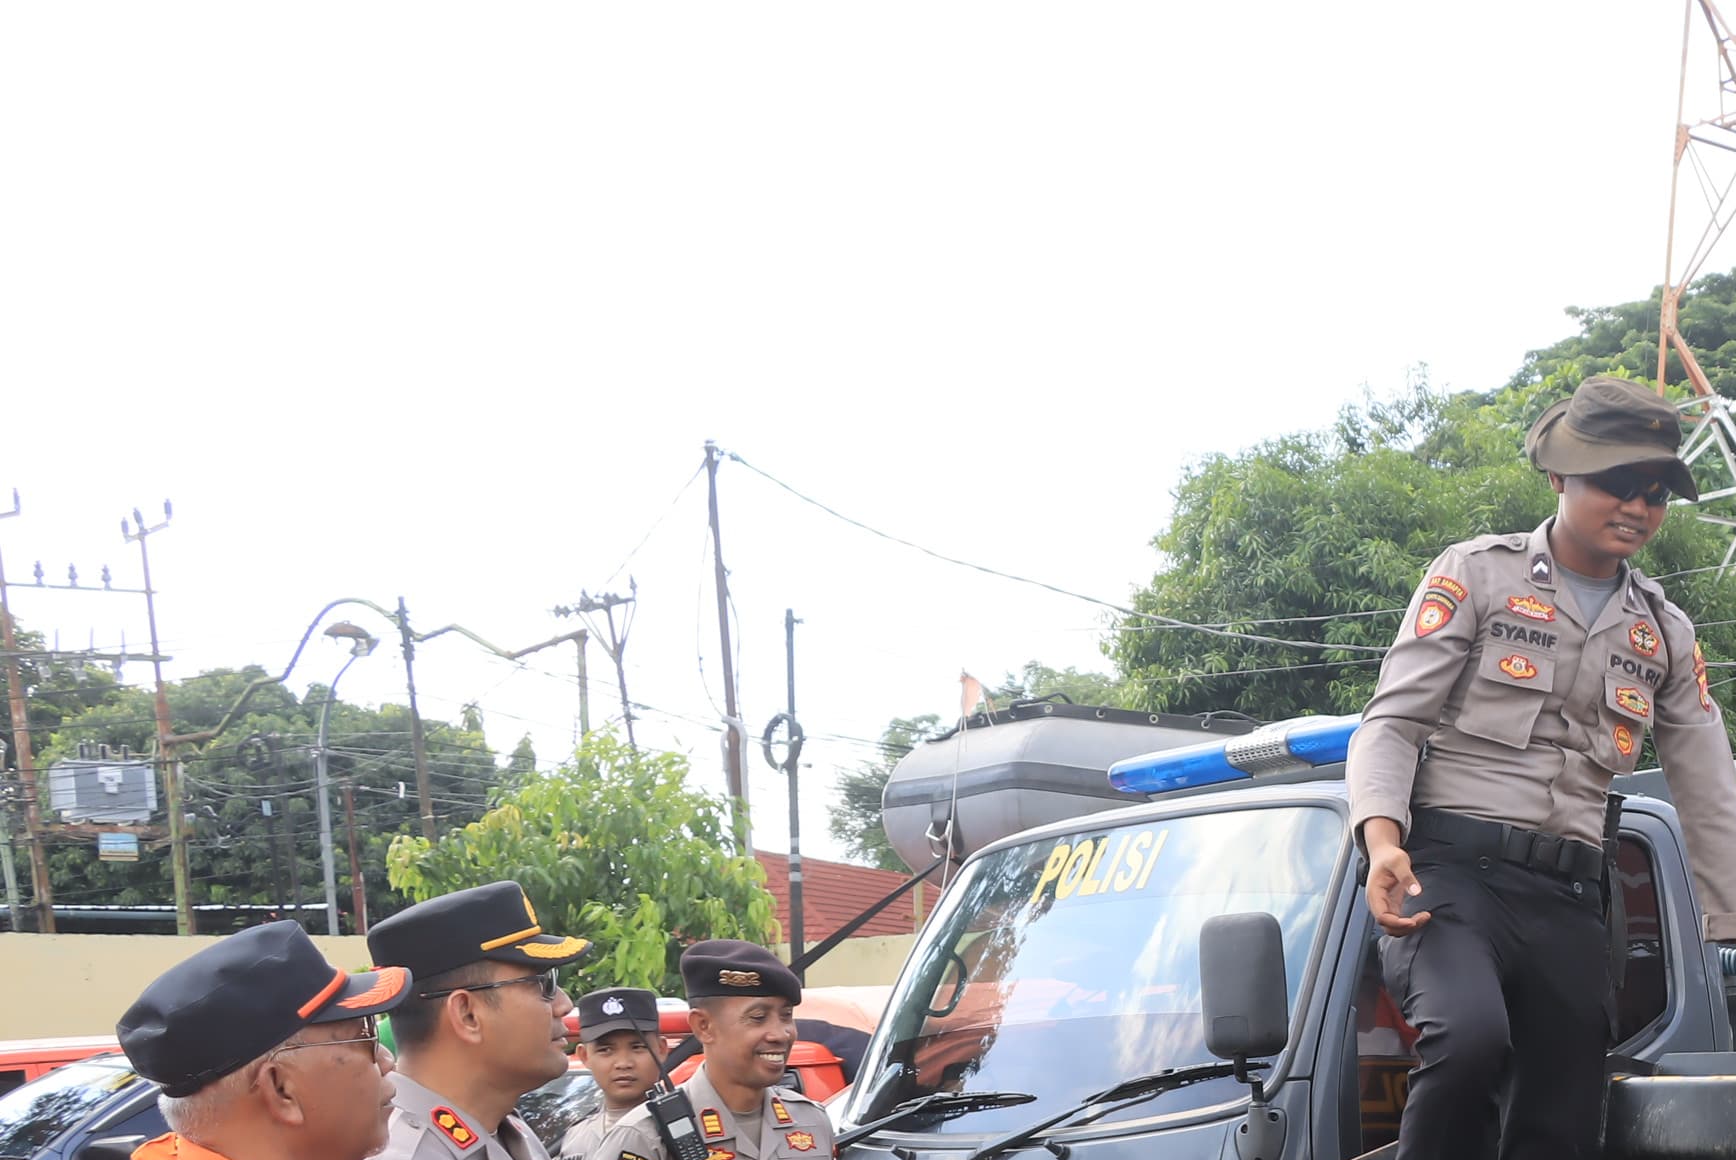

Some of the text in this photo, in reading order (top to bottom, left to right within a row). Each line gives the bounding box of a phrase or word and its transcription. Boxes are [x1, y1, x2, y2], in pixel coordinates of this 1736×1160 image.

[1490, 621, 1557, 649] SYARIF
[1610, 653, 1660, 689] POLRI
[1032, 829, 1169, 904] POLISI
